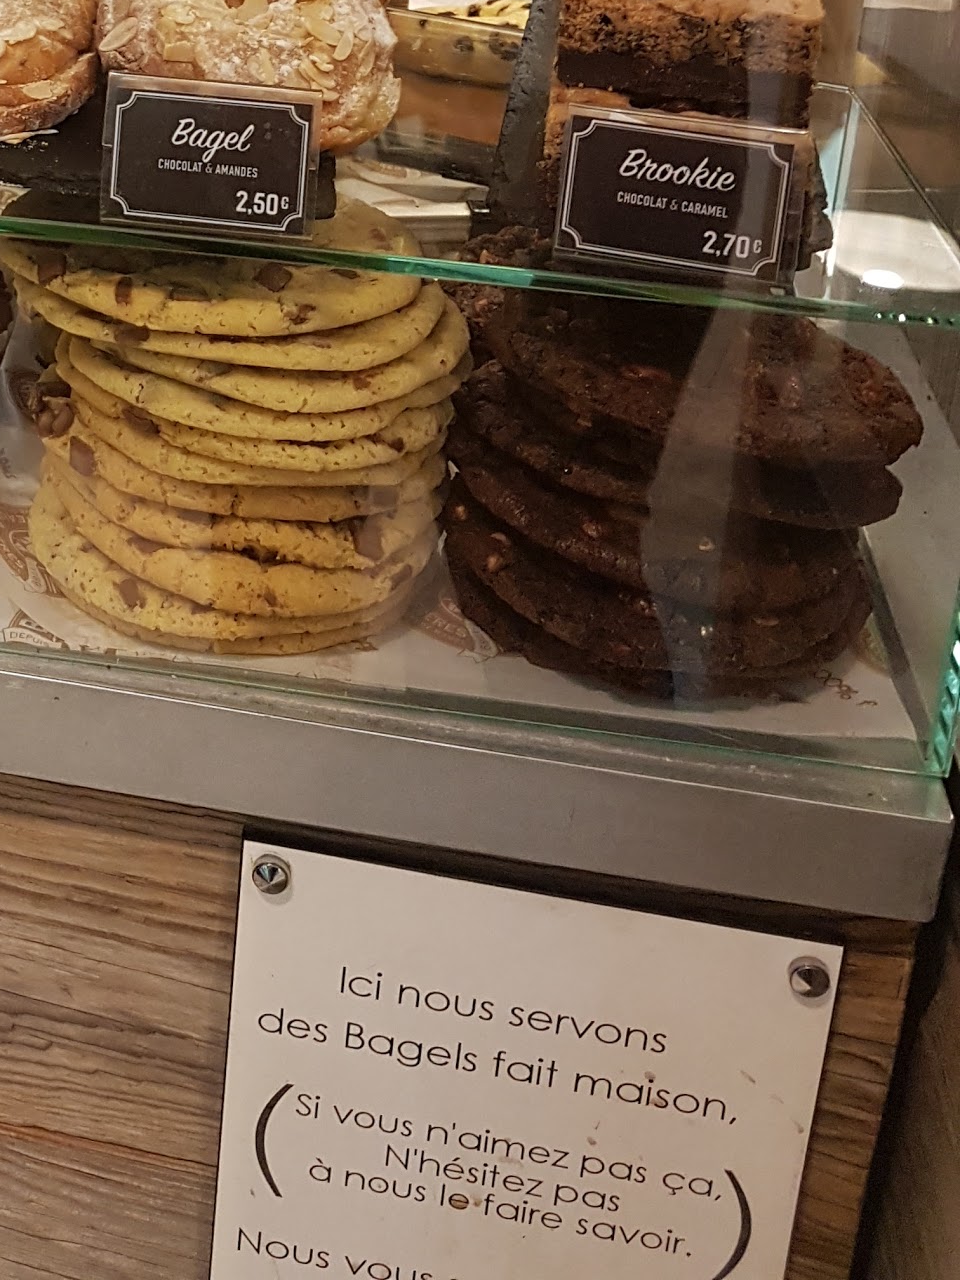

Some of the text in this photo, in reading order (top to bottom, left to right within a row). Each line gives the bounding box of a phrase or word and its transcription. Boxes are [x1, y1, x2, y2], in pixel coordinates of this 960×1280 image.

[158, 158, 258, 178] CHOCOLAT & AMANDES
[171, 118, 255, 163] Bagel
[619, 148, 736, 192] Brookie
[617, 191, 729, 219] CHOCOLAT & CARAMEL
[340, 966, 668, 1053] Ici nous servons
[258, 1007, 737, 1125] des Bagels fait maison,
[295, 1093, 723, 1201] Si vous n'aimez pas ça,
[384, 1144, 620, 1212] N'hésitez pas
[308, 1157, 692, 1257] à nous le faire savoir.
[237, 1226, 330, 1269] Nous
